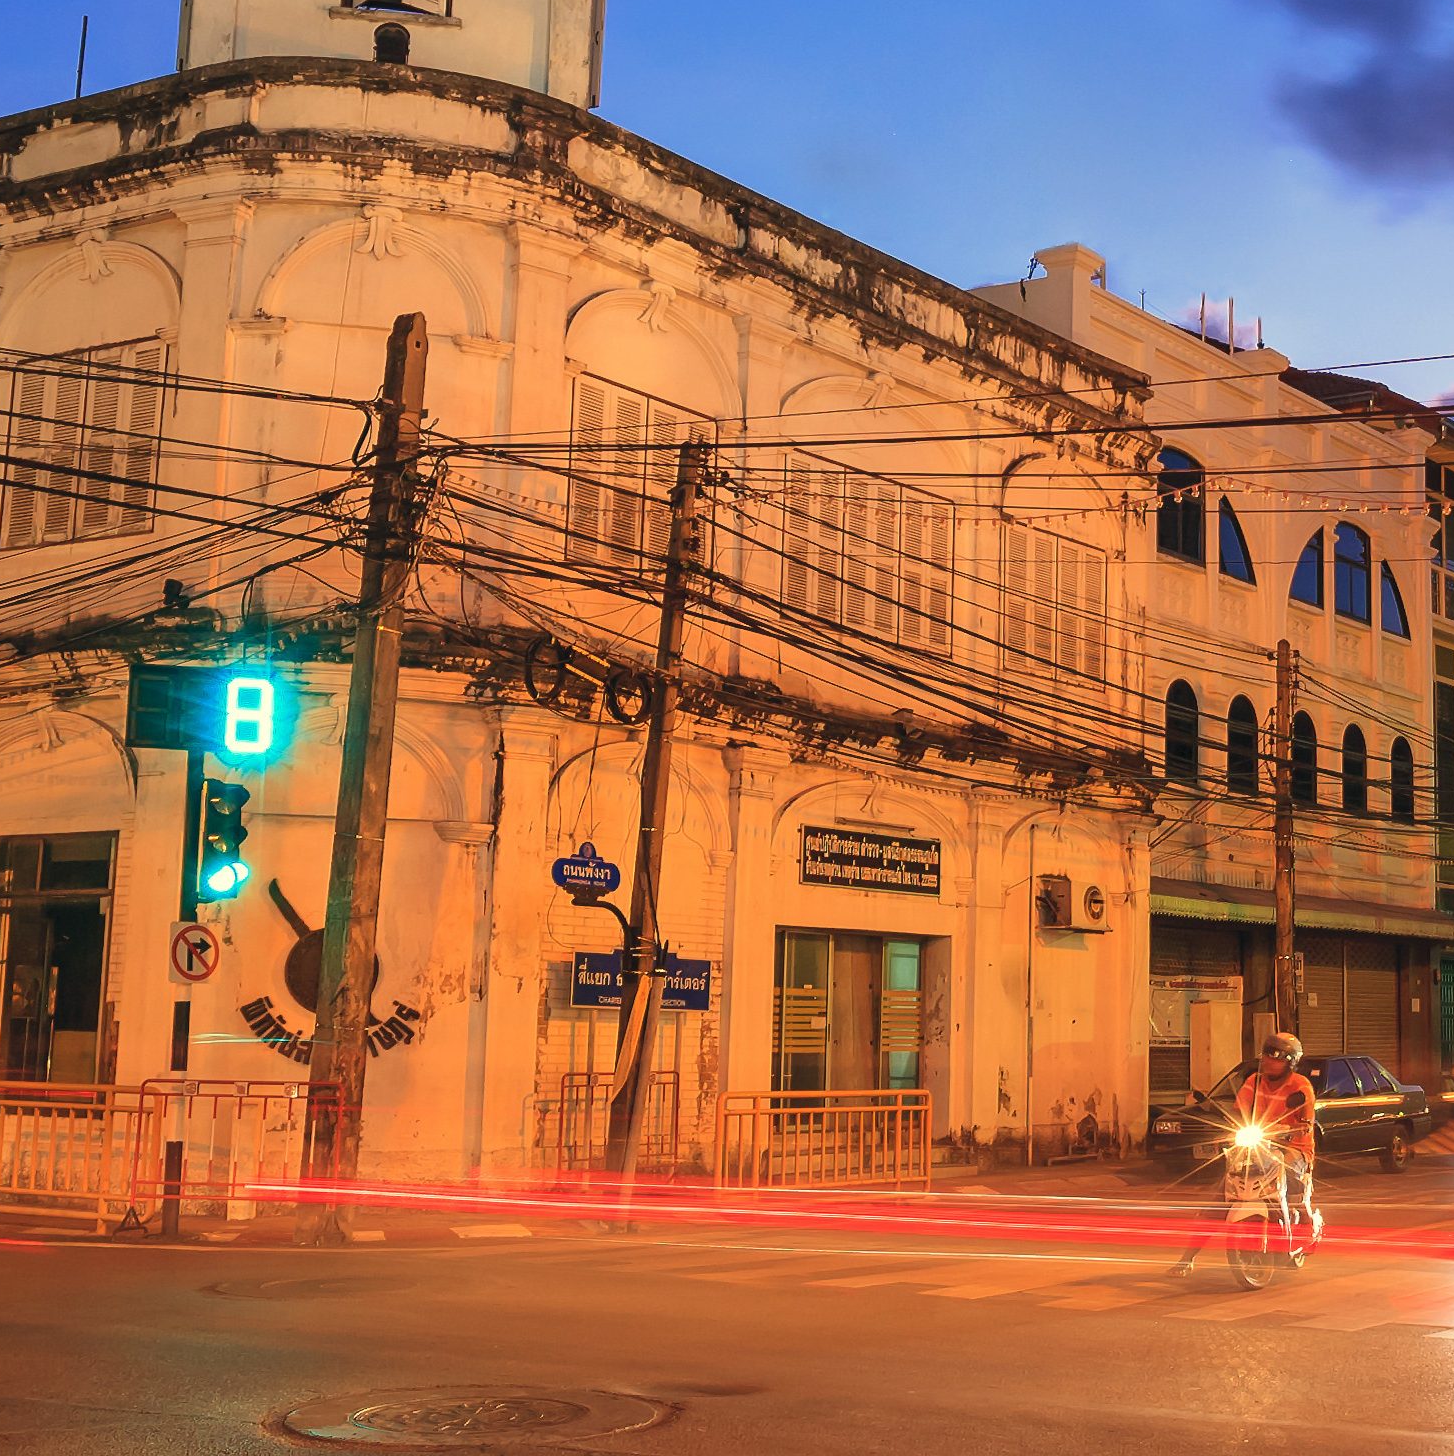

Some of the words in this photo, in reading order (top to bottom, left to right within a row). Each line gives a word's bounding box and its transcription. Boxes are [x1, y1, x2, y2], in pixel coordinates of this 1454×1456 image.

[225, 677, 274, 753] 8
[563, 861, 611, 880] ถนนพังงา
[578, 958, 611, 985] สี่แยก
